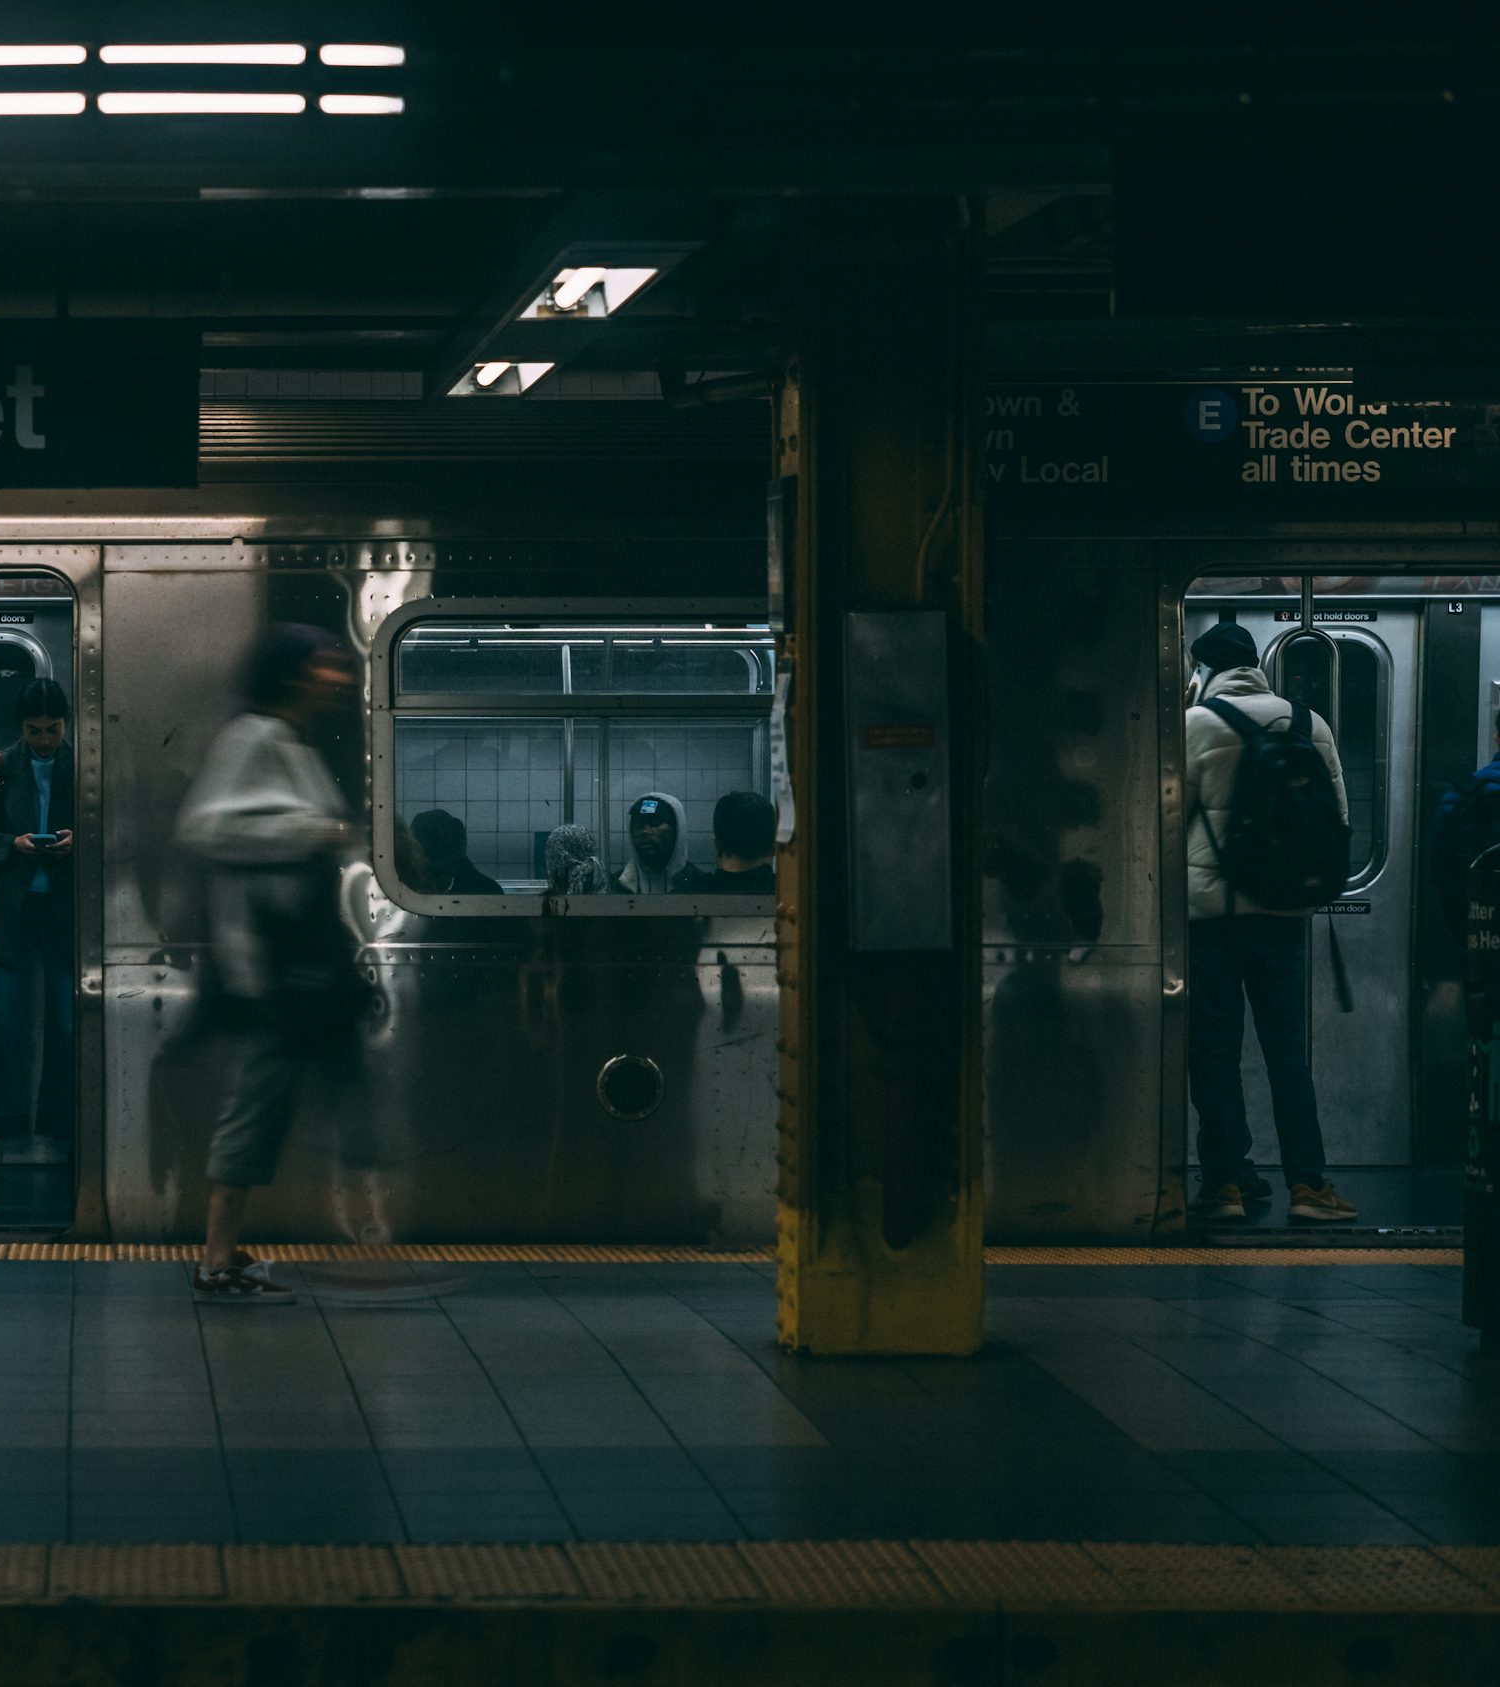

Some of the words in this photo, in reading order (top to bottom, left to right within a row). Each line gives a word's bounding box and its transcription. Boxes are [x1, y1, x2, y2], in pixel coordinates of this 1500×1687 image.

[1056, 388, 1081, 417] &
[1199, 400, 1222, 430] E
[1241, 387, 1281, 416] To
[1241, 420, 1331, 449] Trade
[1344, 419, 1457, 449] Center
[1020, 456, 1109, 484] Local
[1241, 454, 1277, 483] all
[1291, 453, 1381, 483] times
[1, 614, 26, 623] doors
[1324, 612, 1343, 620] hold
[1344, 612, 1369, 620] doors
[1448, 603, 1463, 613] L3
[1334, 905, 1346, 913] on
[1347, 904, 1367, 913] door
